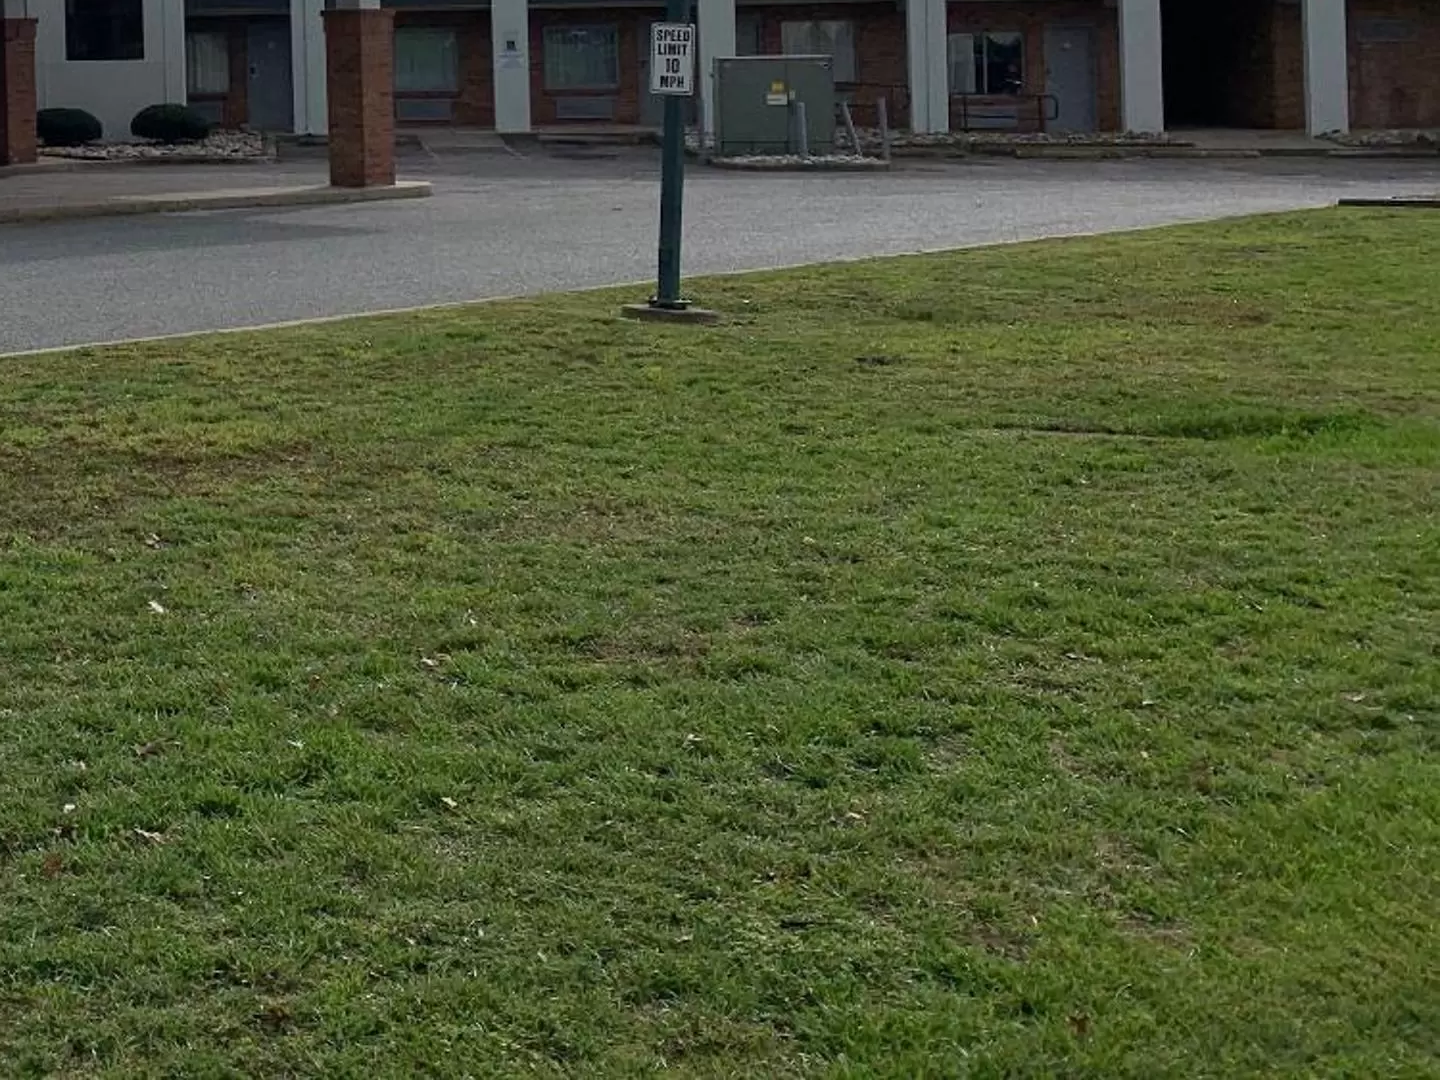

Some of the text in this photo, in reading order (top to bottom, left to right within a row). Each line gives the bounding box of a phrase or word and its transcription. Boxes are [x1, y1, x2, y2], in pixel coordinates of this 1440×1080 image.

[656, 29, 690, 42] SPEED
[657, 43, 688, 56] LIMIT
[665, 58, 681, 73] 10
[660, 75, 685, 88] MPH
